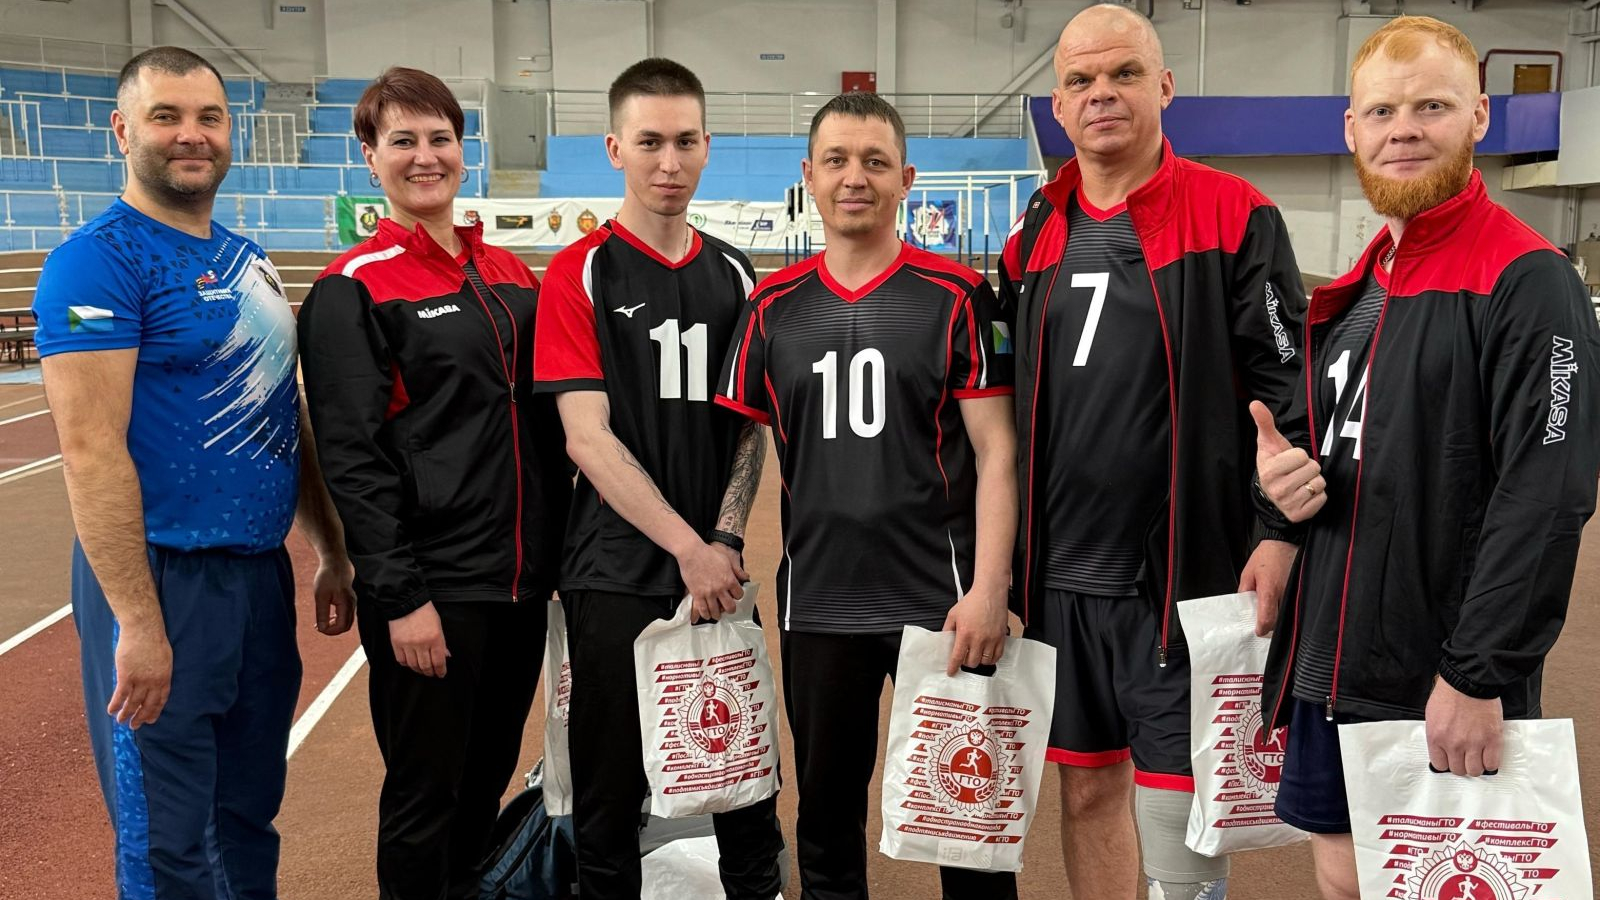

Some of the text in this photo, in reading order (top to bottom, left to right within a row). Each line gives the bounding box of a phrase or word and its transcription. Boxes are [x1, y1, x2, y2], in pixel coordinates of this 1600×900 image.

[417, 304, 461, 319] MIKASA
[1070, 271, 1111, 367] 7
[649, 318, 708, 401] 11
[811, 347, 887, 440] 10
[1543, 335, 1579, 446] MIKASA
[706, 726, 725, 737] ГТО
[959, 774, 982, 787] ГТО
[1386, 816, 1456, 828] #талисманыГТО
[1475, 820, 1548, 832] #фестивальГТО
[1388, 830, 1457, 841] #нормативыГТО
[1485, 837, 1549, 848] #комплексГТО
